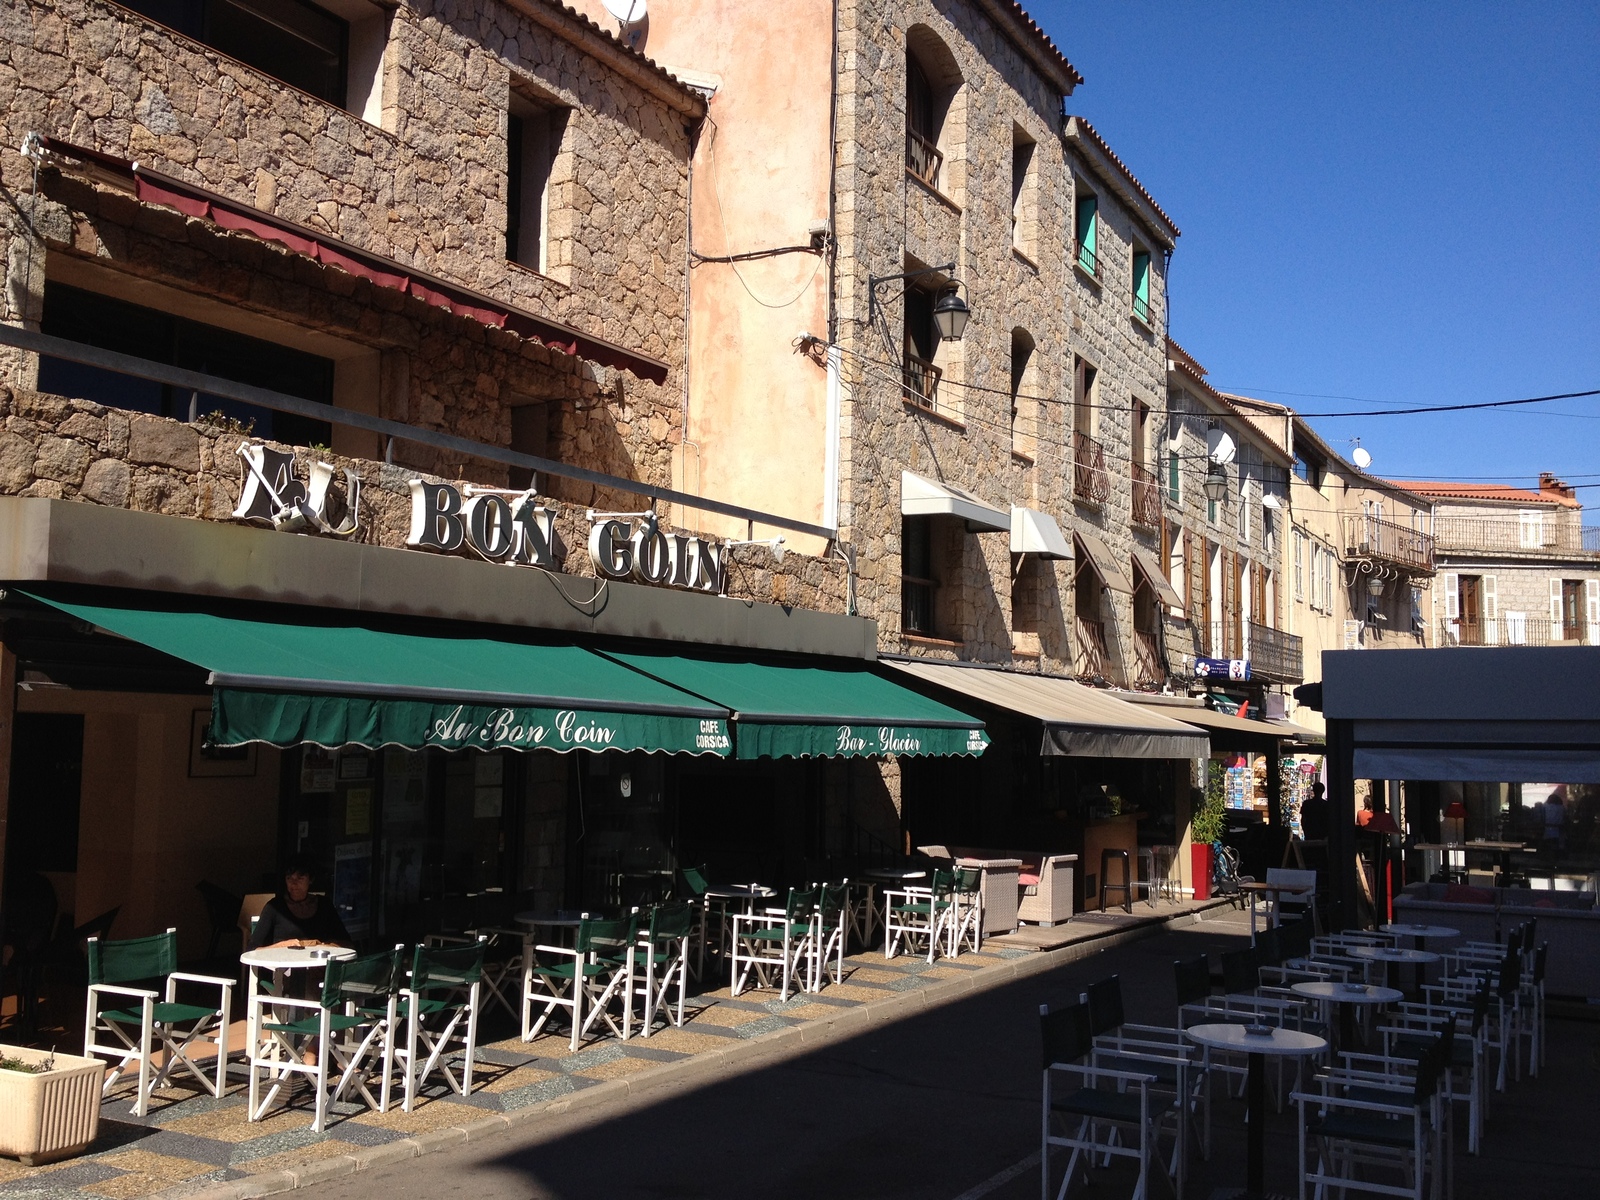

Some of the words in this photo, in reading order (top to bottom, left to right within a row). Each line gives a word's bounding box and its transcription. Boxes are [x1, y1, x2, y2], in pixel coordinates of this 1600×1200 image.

[406, 479, 557, 566] BON
[588, 519, 724, 593] COIN
[425, 704, 478, 742] Au
[480, 707, 551, 744] Bon
[554, 710, 616, 744] Coin
[700, 720, 719, 734] CAFE
[695, 734, 730, 749] CORSICA
[835, 725, 867, 751] Bar
[878, 726, 921, 751] Glacier
